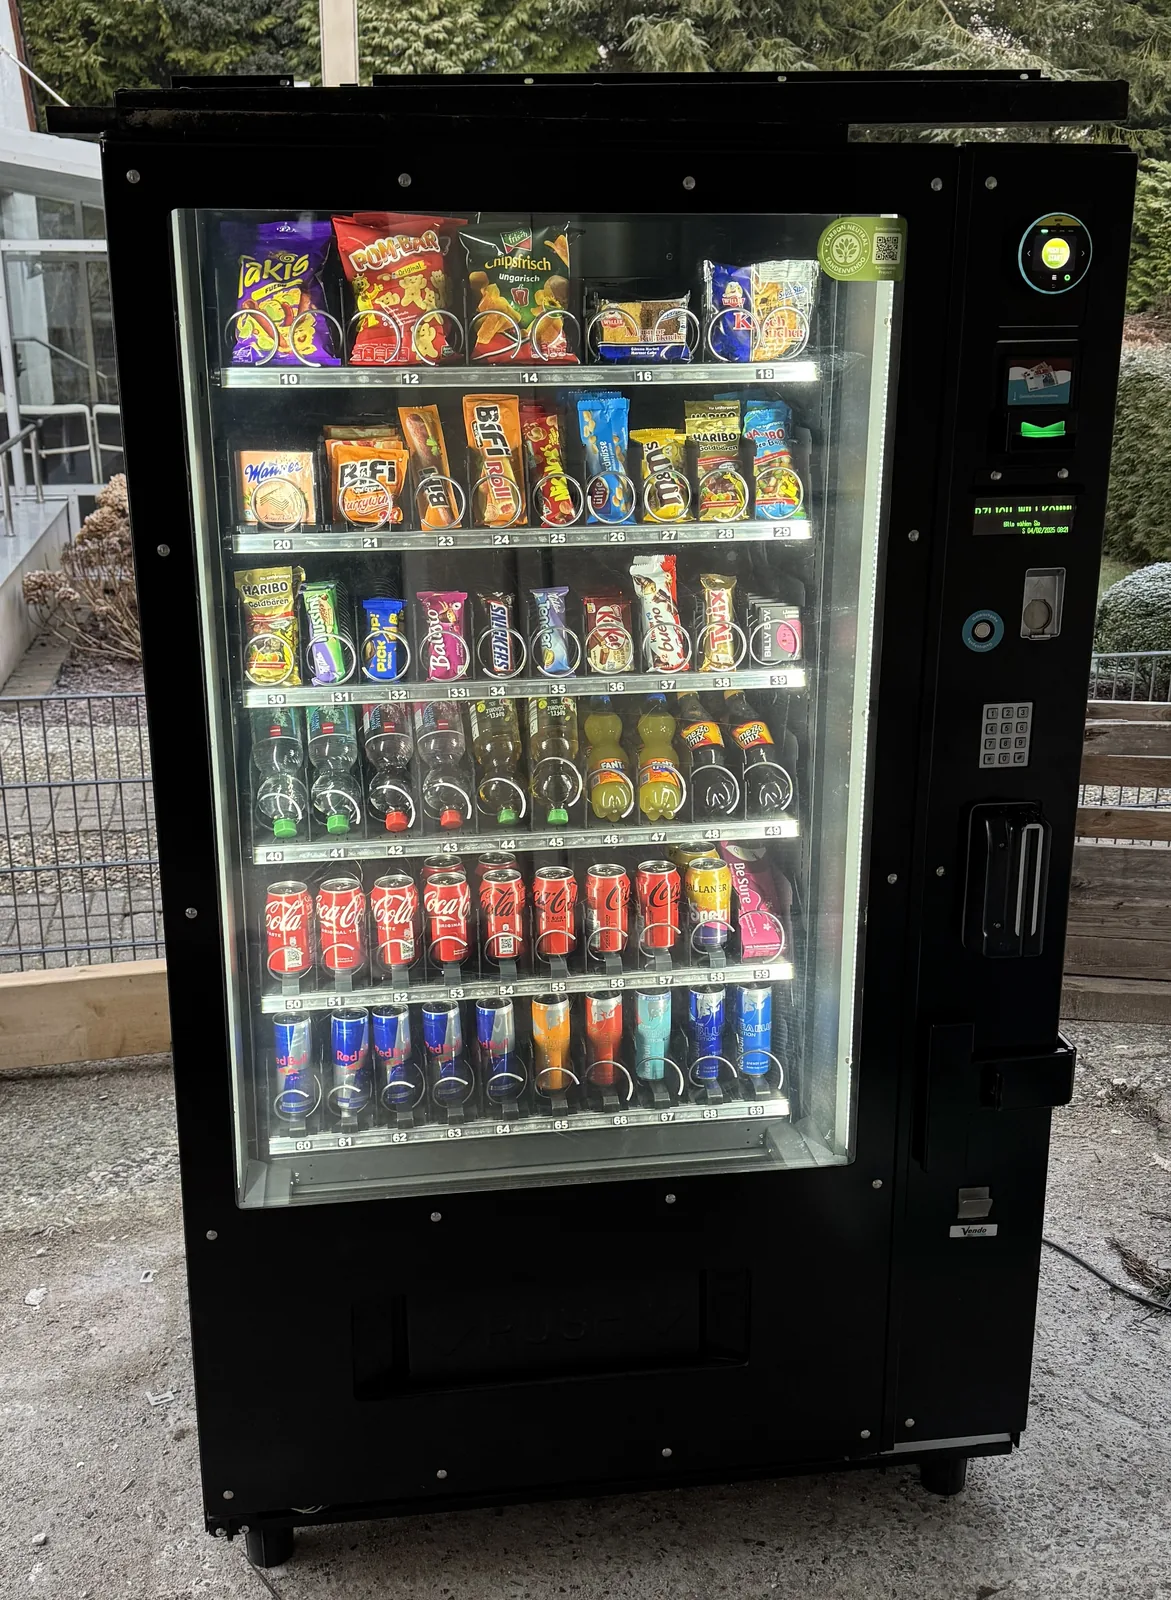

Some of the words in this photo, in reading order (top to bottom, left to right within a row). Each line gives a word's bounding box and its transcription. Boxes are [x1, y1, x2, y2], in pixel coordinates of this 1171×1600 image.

[825, 224, 846, 246] CARBON
[847, 224, 869, 246] NEUTRAL
[397, 262, 422, 276] Original
[825, 256, 866, 274] SANDENVENDO
[498, 272, 540, 284] ungarisch
[522, 373, 538, 383] 14
[637, 372, 652, 381] 16
[758, 370, 772, 378] 18
[281, 374, 298, 384] 10
[402, 374, 419, 384] 12
[693, 432, 737, 442] HARIBO
[662, 532, 677, 540] 27
[718, 530, 734, 538] 28
[775, 528, 790, 536] 29
[438, 537, 454, 546] 23
[494, 536, 510, 544] 24
[551, 534, 566, 543] 25
[610, 533, 626, 542] 26
[274, 540, 290, 550] 20
[364, 538, 378, 548] 21
[242, 580, 289, 596] HARIBO
[248, 597, 289, 608] Goldbären
[538, 600, 556, 649] Tender
[652, 607, 675, 652] bueno
[490, 602, 510, 672] SNICKERS
[763, 630, 772, 658] BILLY
[715, 679, 730, 687] 38
[772, 676, 786, 684] 39
[551, 685, 566, 693] 35
[610, 682, 624, 691] 36
[661, 681, 676, 689] 37
[391, 690, 407, 699] 32
[450, 689, 466, 697] 33
[490, 687, 505, 696] 34
[268, 695, 284, 704] 30
[334, 692, 348, 701] 31
[684, 725, 710, 741] mezzo
[738, 724, 764, 741] mezzo
[689, 734, 706, 748] mix
[743, 734, 762, 746] mix
[600, 760, 625, 770] FANT
[705, 830, 719, 838] 48
[766, 826, 780, 835] 49
[604, 835, 618, 844] 46
[652, 833, 666, 841] 47
[501, 840, 515, 848] 44
[550, 838, 564, 846] 45
[330, 848, 344, 857] 41
[388, 846, 402, 854] 42
[443, 844, 458, 852] 43
[266, 852, 282, 861] 40
[734, 862, 746, 876] Be
[738, 878, 752, 904] Sure
[711, 973, 724, 981] 58
[755, 970, 769, 978] 59
[611, 980, 624, 988] 56
[660, 976, 672, 984] 57
[500, 986, 513, 994] 54
[552, 983, 565, 991] 55
[393, 993, 408, 1002] 52
[450, 990, 464, 998] 53
[286, 1000, 301, 1009] 50
[328, 998, 342, 1006] 51
[337, 1050, 358, 1062] Red
[704, 1110, 717, 1118] 68
[750, 1106, 763, 1114] 69
[614, 1116, 628, 1124] 66
[661, 1113, 674, 1121] 67
[555, 1121, 568, 1129] 65
[448, 1129, 462, 1138] 63
[497, 1126, 510, 1134] 64
[339, 1138, 352, 1146] 61
[393, 1134, 407, 1142] 62
[296, 1142, 311, 1150] 60
[961, 1226, 987, 1235] Vendo
